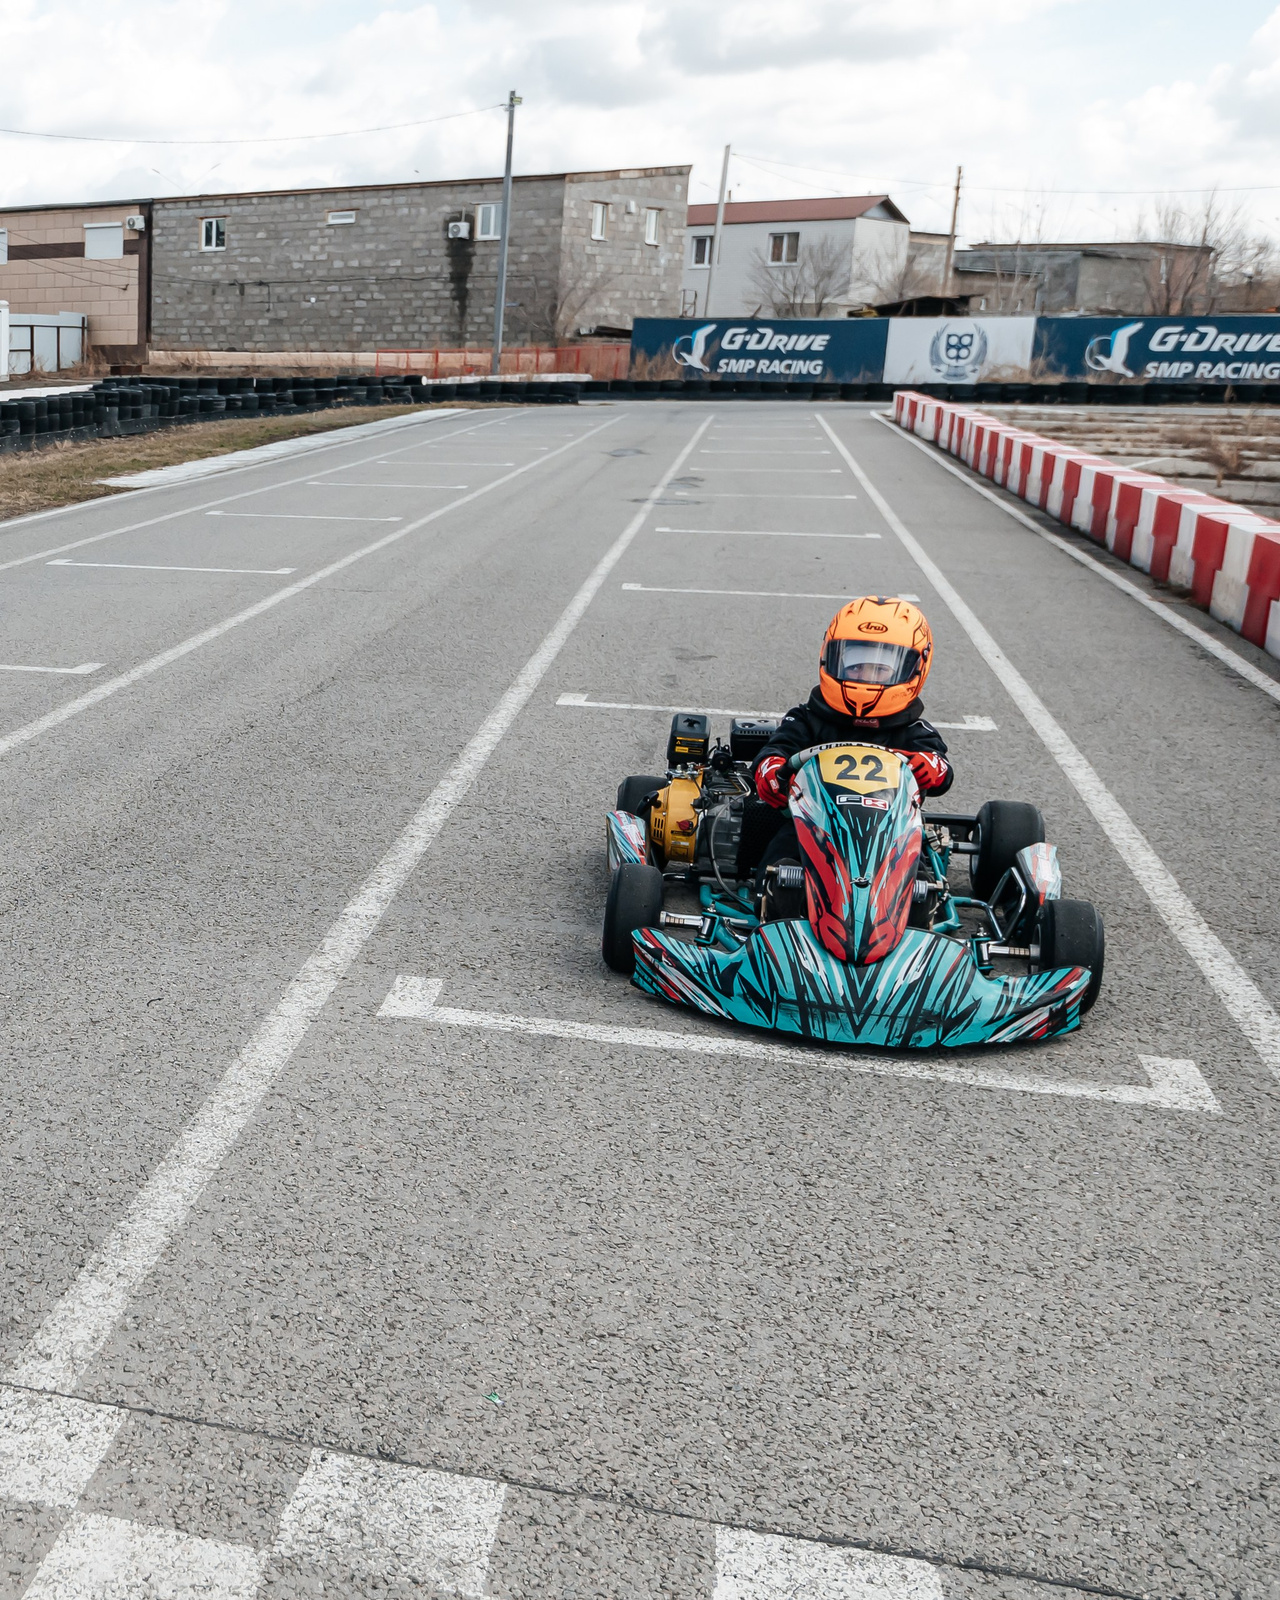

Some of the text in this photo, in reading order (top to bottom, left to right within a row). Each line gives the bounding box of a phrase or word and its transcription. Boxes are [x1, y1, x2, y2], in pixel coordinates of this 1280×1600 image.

[717, 359, 824, 375] SMP RACING
[1144, 362, 1280, 379] SMP RACING
[863, 622, 885, 631] Arai
[834, 754, 888, 783] 22
